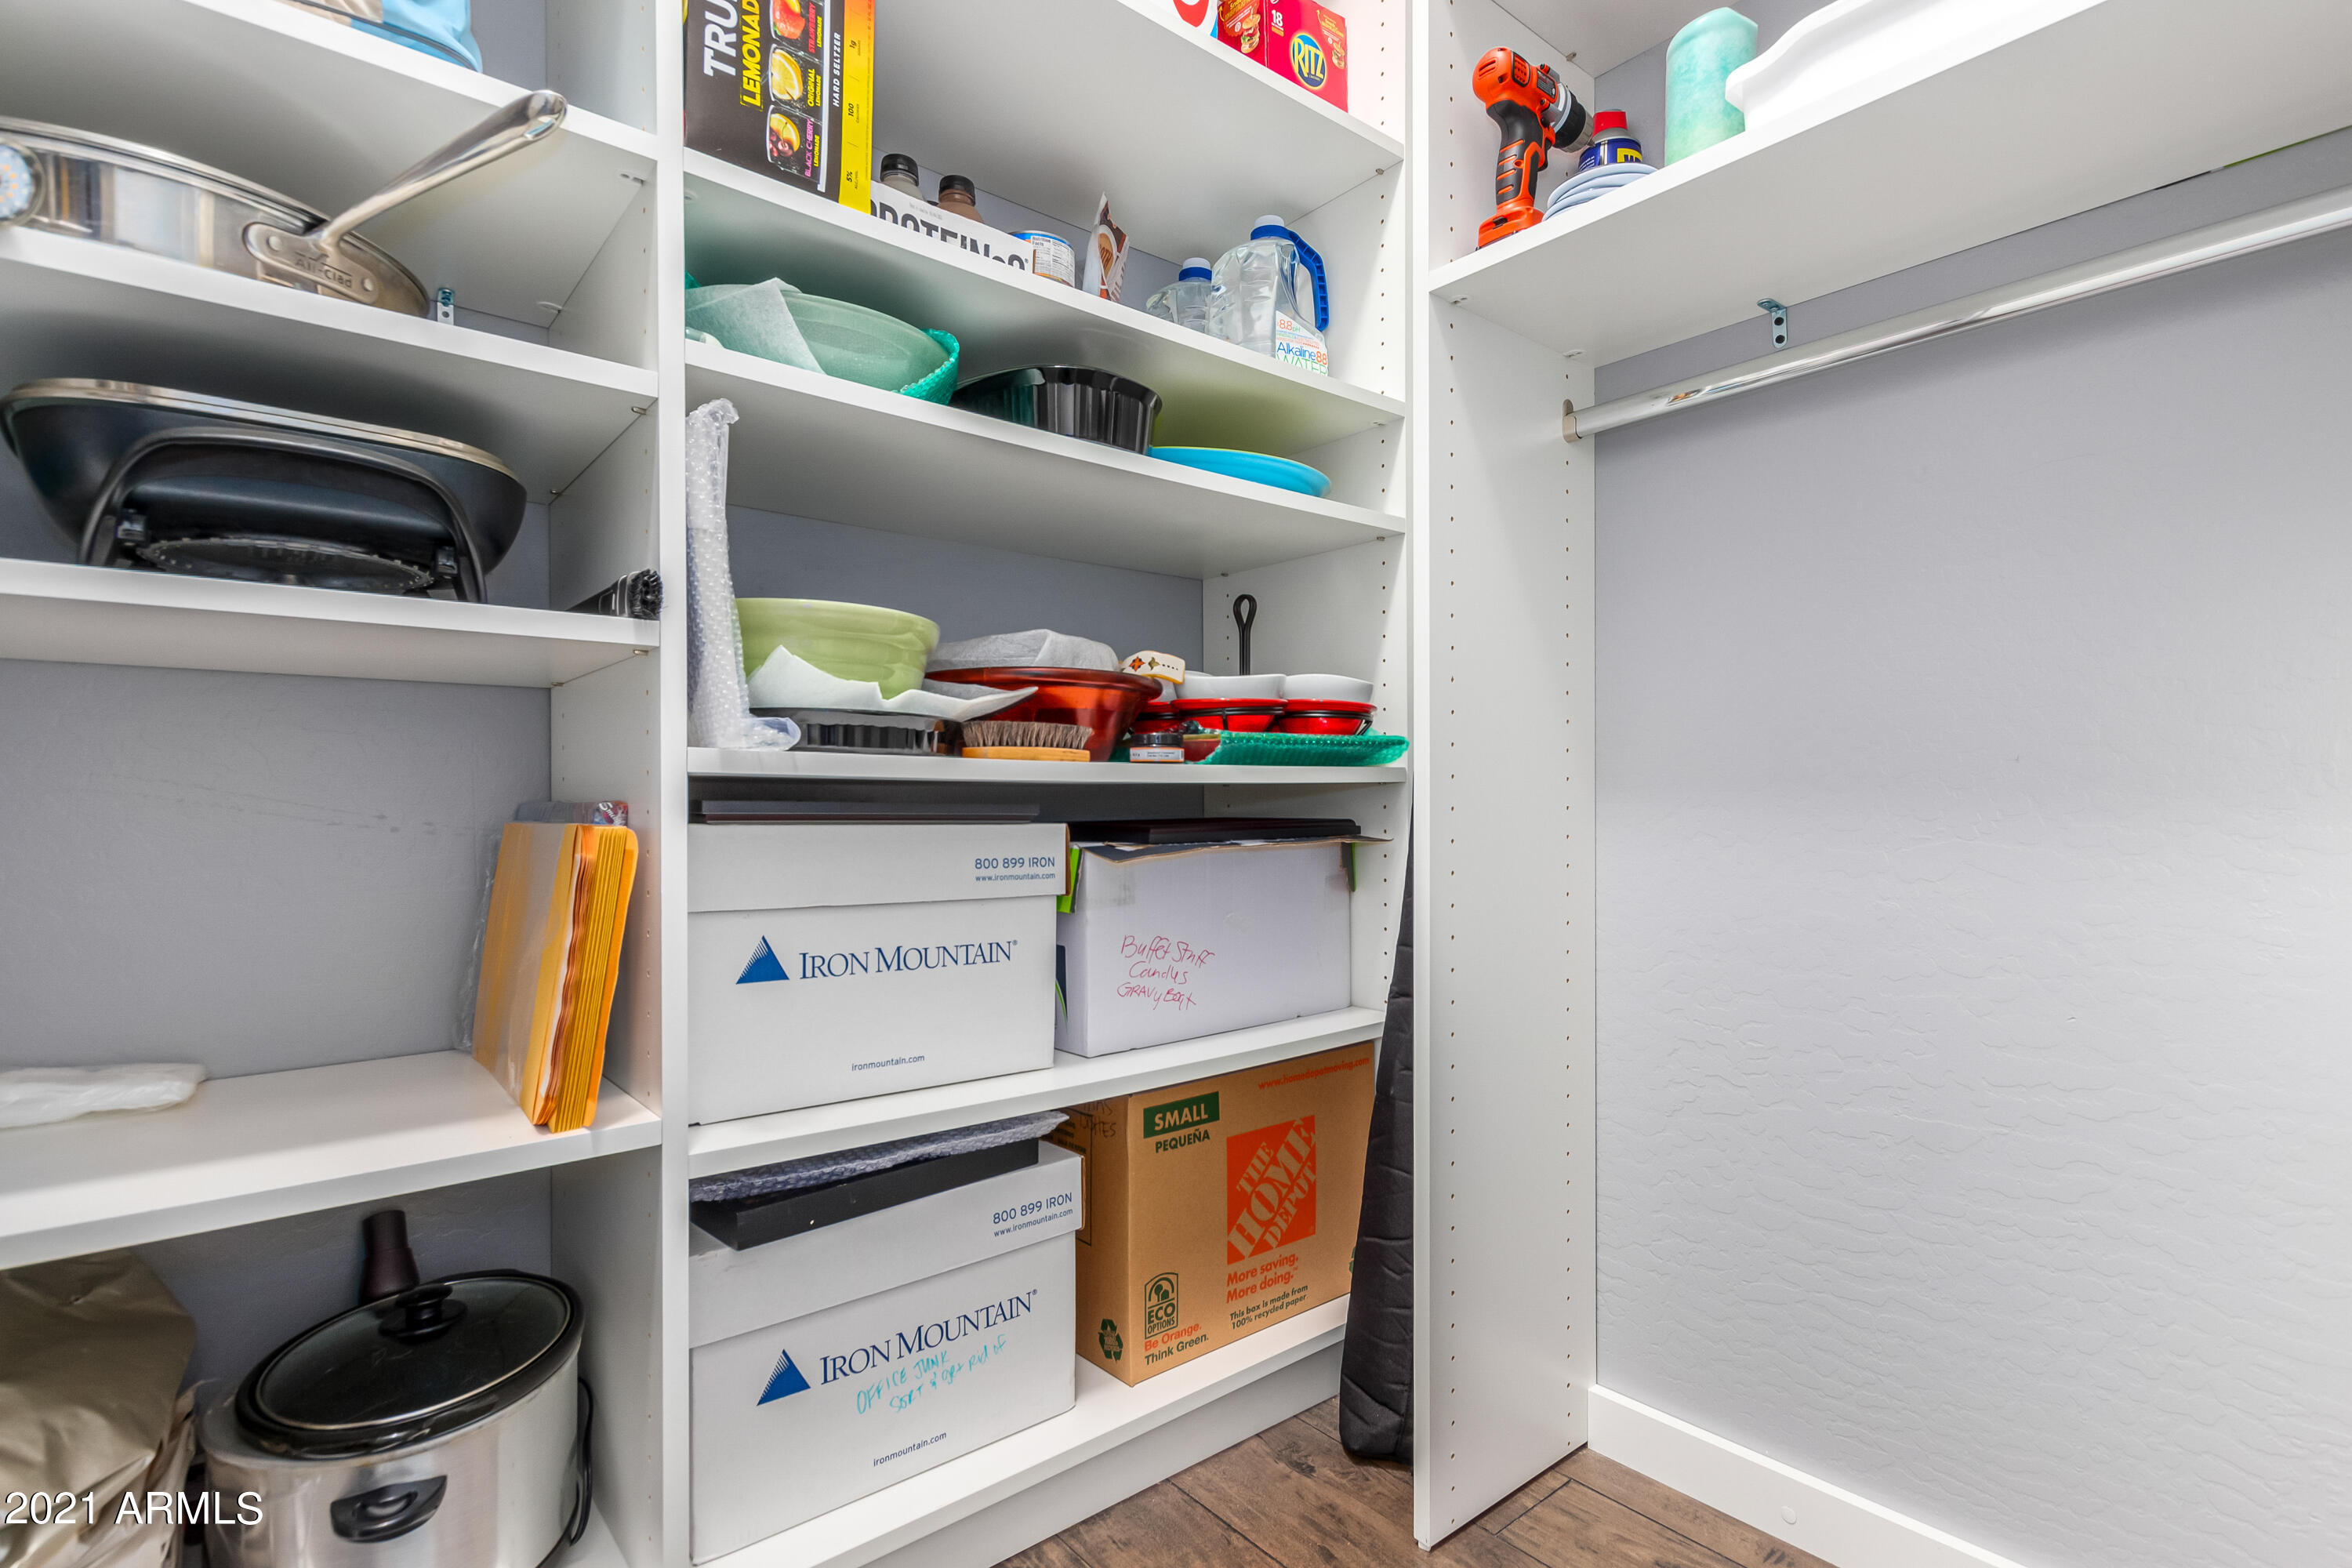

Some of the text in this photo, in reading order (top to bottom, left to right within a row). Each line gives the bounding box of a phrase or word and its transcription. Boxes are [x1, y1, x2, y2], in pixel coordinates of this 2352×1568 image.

[1272, 9, 1283, 27] 18
[703, 0, 738, 76] TRU
[833, 32, 841, 76] SELTZER
[1294, 37, 1324, 79] RITZ
[807, 69, 815, 107] ORIGINAL
[847, 171, 853, 183] 5%
[975, 857, 1055, 869] 800 899 IRON
[975, 873, 1056, 882] www.ironmountain.com
[799, 951, 869, 980] IRON
[851, 1054, 925, 1072] ironmountain.com
[1154, 1103, 1209, 1131] SMALL
[1155, 1128, 1210, 1153] PEQUEÑA
[1236, 1142, 1274, 1196] THE
[1228, 1117, 1316, 1259] HOME
[993, 1192, 1073, 1225] 800 899 IRON
[1263, 1162, 1317, 1248] DEPOT
[993, 1209, 1073, 1237] www.ironmountain.com
[1226, 1254, 1299, 1287] More saving.
[1225, 1271, 1294, 1304] More doing.
[1229, 1309, 1244, 1321] This
[1246, 1303, 1261, 1315] box
[1270, 1291, 1290, 1304] made
[1291, 1285, 1308, 1296] from
[1147, 1302, 1176, 1325] ECO
[1147, 1316, 1175, 1334] OPTIONS
[1232, 1316, 1253, 1330] 100%
[1254, 1301, 1285, 1321] recycled
[1144, 1323, 1202, 1352] Be Orange.
[1145, 1334, 1209, 1366] Think Green.
[820, 1340, 891, 1385] IRON
[856, 1349, 951, 1414] OFFICE JUNK
[873, 1432, 947, 1467] ironmountain.com
